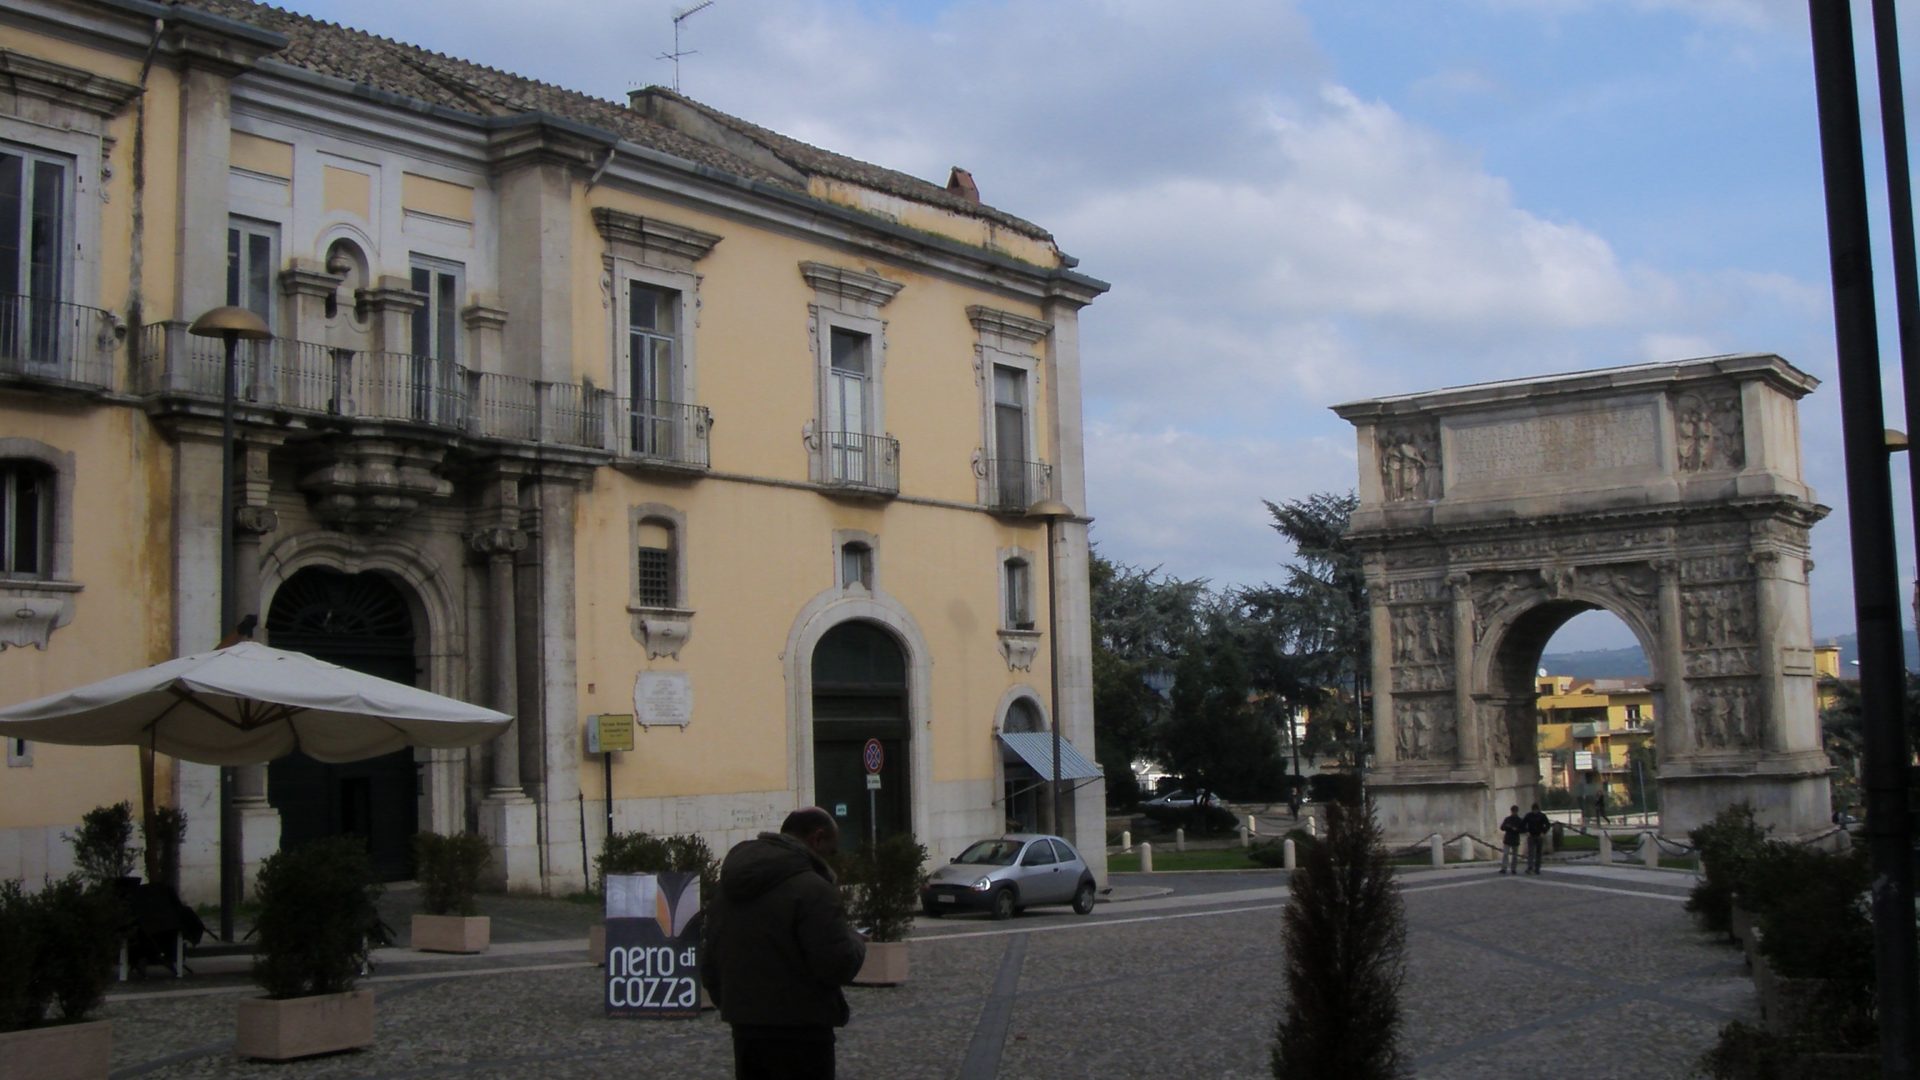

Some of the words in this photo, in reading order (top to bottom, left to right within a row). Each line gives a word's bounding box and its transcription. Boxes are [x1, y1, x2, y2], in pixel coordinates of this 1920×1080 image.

[609, 946, 675, 977] nero
[679, 947, 696, 967] di
[609, 976, 696, 1008] cozza
